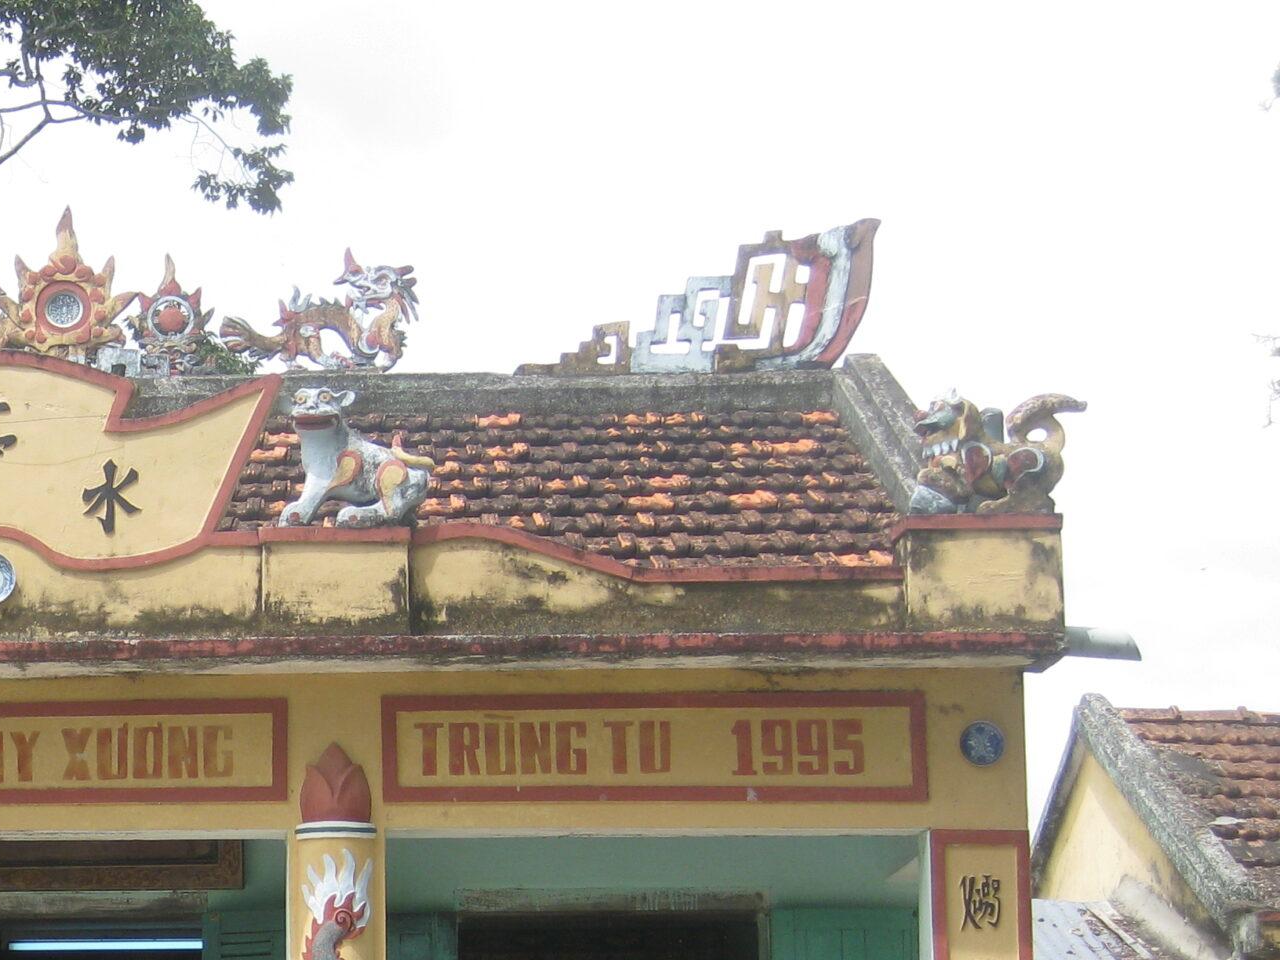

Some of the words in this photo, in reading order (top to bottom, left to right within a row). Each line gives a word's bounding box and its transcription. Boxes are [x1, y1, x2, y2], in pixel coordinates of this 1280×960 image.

[61, 722, 233, 780] XƯƠNG
[603, 719, 671, 775] TU
[730, 719, 864, 776] 1995
